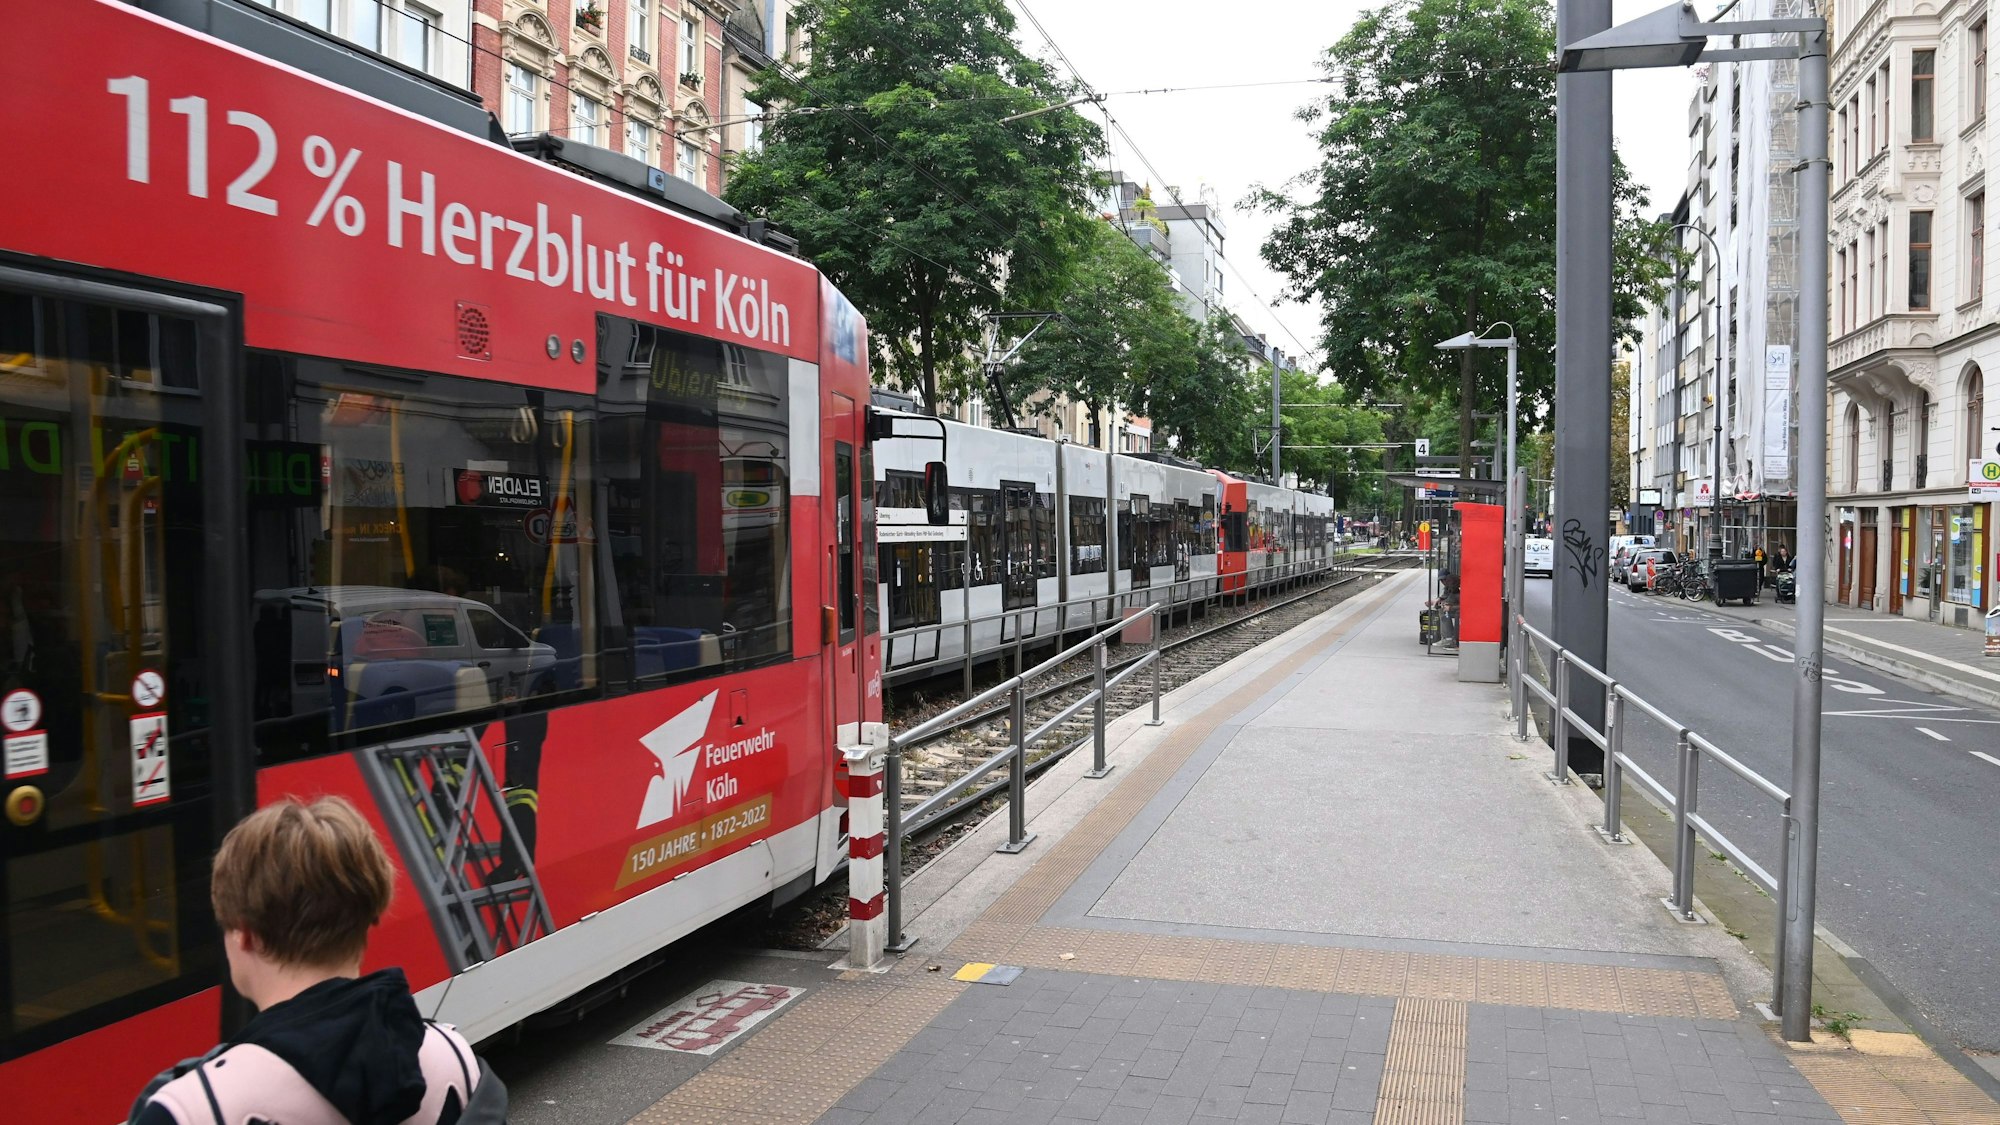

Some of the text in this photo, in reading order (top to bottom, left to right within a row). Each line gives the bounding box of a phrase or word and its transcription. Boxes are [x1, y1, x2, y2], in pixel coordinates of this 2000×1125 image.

[107, 75, 790, 347] 112 % Herzblut für Köln
[1418, 444, 1427, 455] 4
[1705, 628, 1887, 694] BUS
[706, 727, 776, 768] Feuerwehr
[706, 773, 738, 804] Köln
[632, 804, 767, 873] 150 JAHRE 1872-2022
